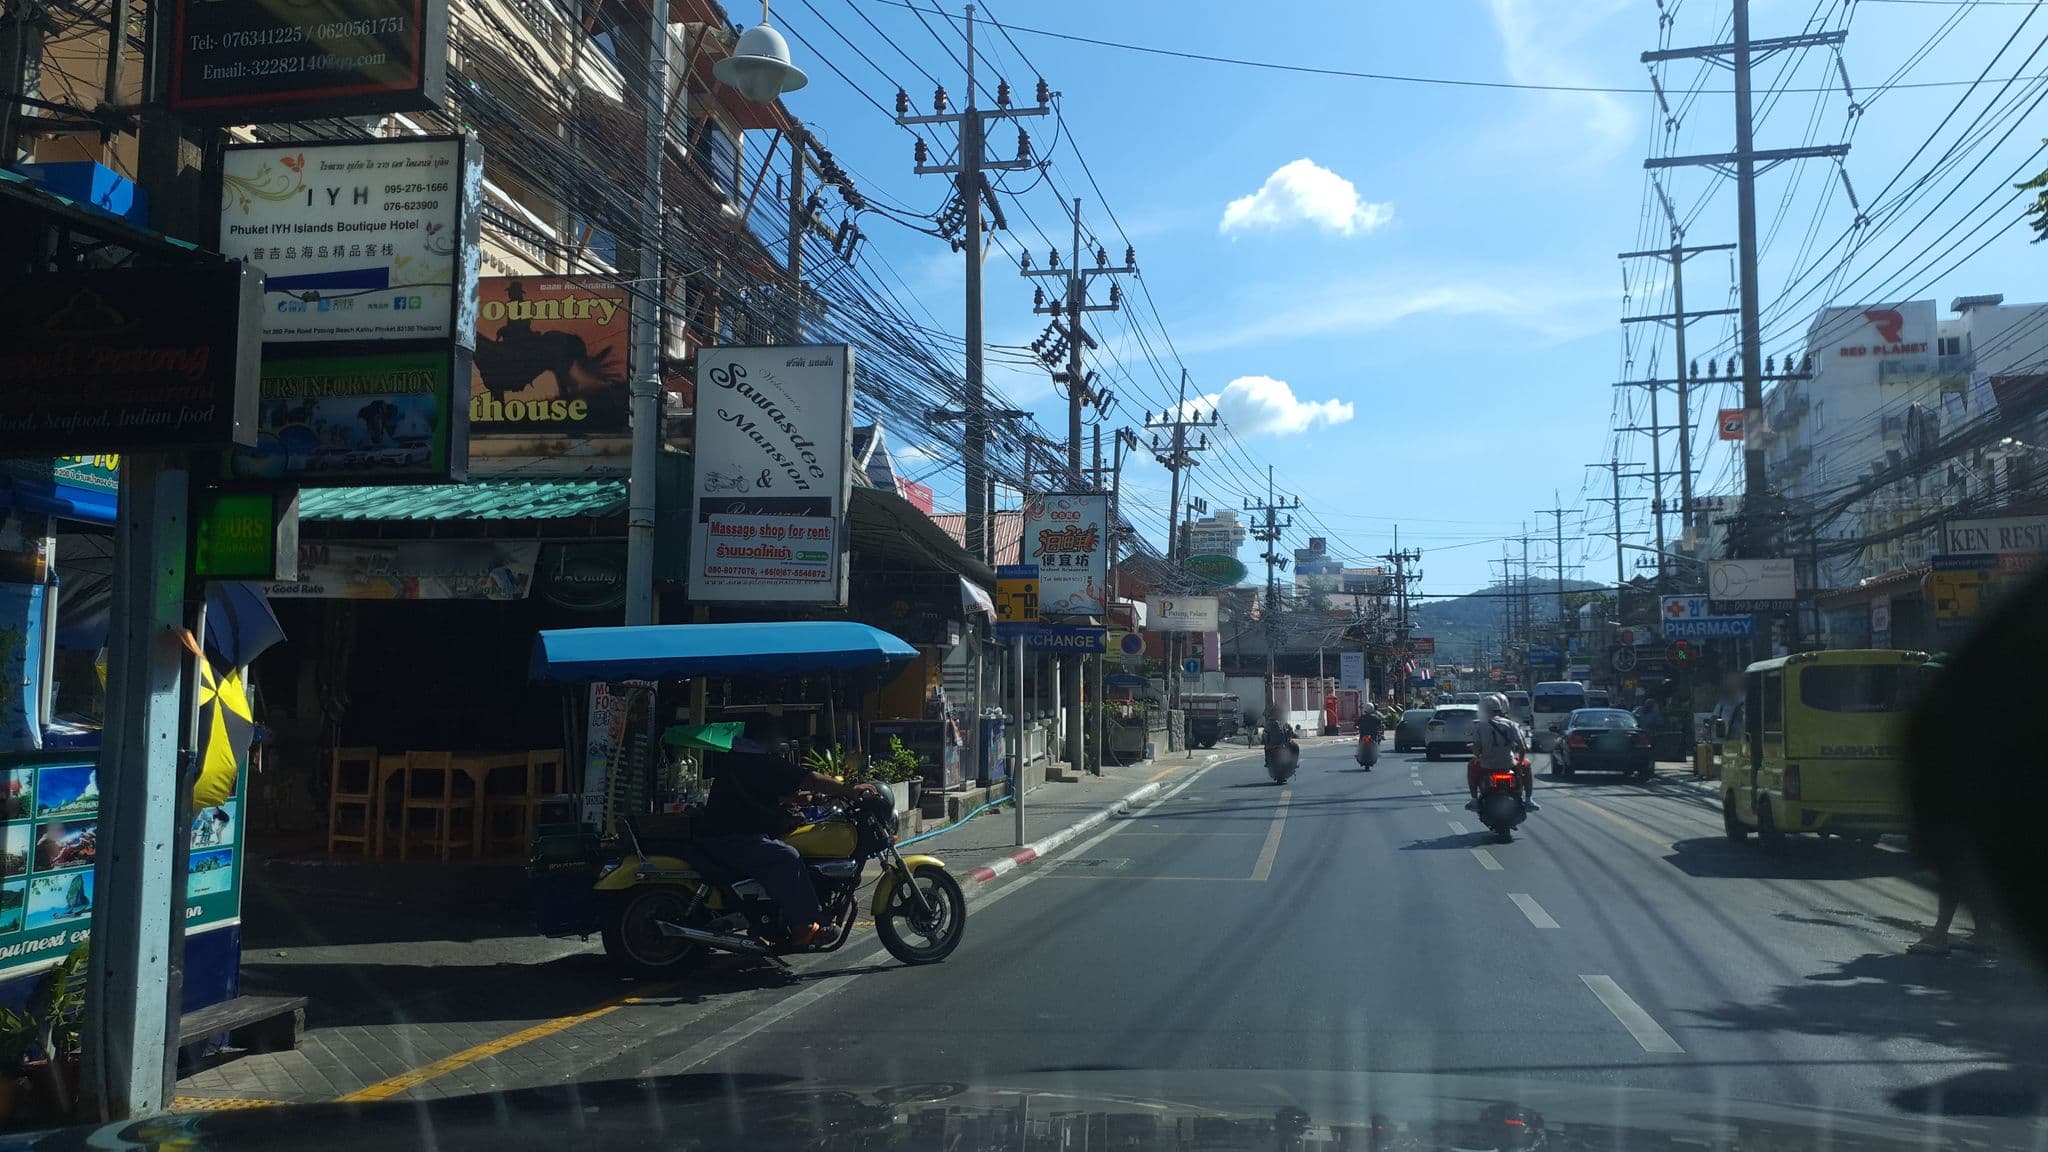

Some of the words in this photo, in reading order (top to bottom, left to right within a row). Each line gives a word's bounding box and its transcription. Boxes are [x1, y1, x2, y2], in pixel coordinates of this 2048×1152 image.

[222, 25, 302, 49] 076341225
[317, 16, 406, 41] 0620561751
[384, 182, 449, 194] 095-276-1666
[383, 201, 439, 211] 076-623900
[230, 224, 269, 236] Phuket
[271, 222, 291, 234] IYH
[294, 221, 333, 234] Islands
[337, 220, 387, 233] Boutique
[390, 219, 419, 231] Hotel
[478, 294, 624, 326] ountry
[1839, 346, 1867, 358] RED
[1872, 342, 1928, 356] PLANET
[470, 391, 588, 422] thouse
[756, 468, 773, 489] &
[710, 520, 755, 540] Massage
[759, 522, 785, 539] shop
[788, 523, 806, 538] for
[807, 526, 830, 540] rent
[1949, 527, 1990, 552] KEN
[1041, 554, 1090, 567] 便宜坊
[272, 584, 299, 594] Good
[301, 584, 325, 594] Rate
[1665, 619, 1752, 636] PHARMACY
[1011, 634, 1095, 648] XCHANGE
